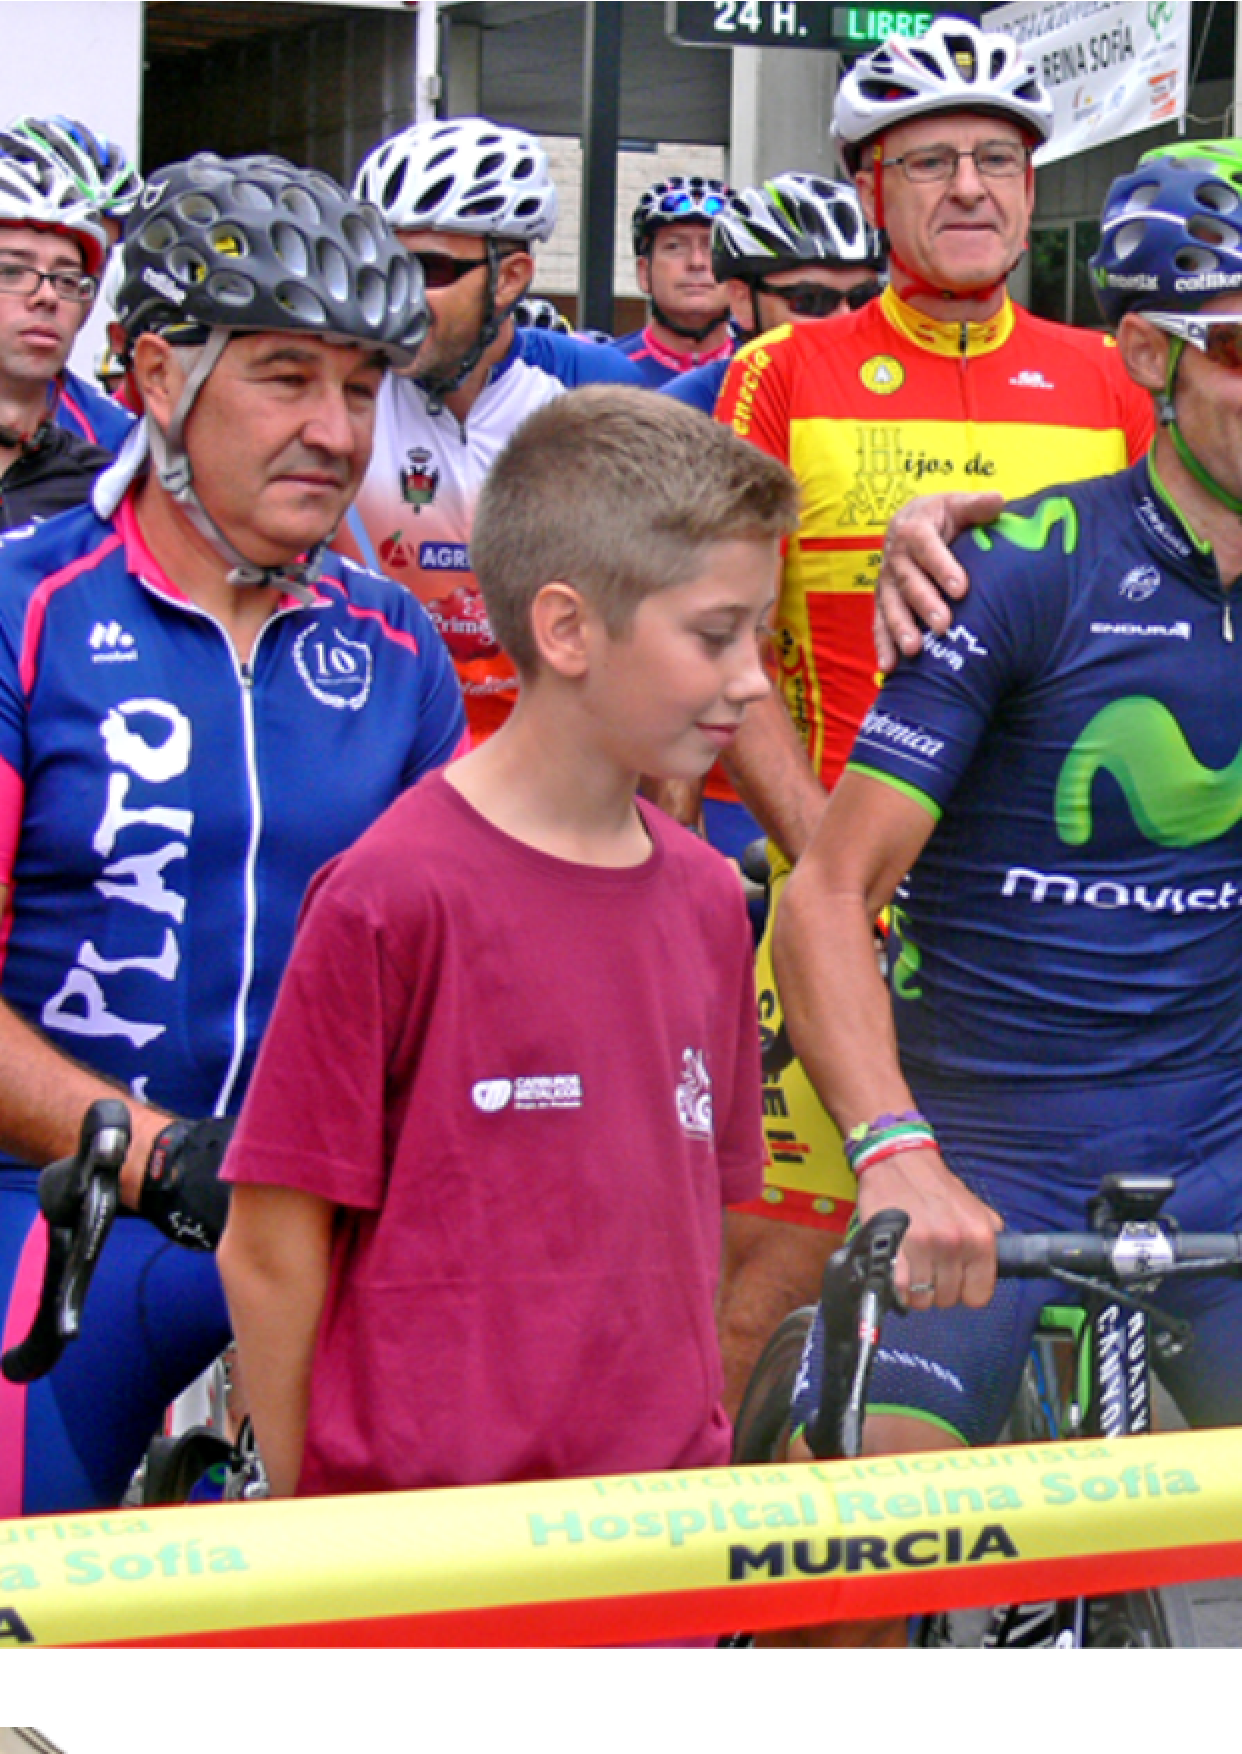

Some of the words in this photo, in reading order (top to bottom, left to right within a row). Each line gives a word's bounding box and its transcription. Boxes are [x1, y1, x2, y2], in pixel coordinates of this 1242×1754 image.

[713, 1, 762, 33] 24
[848, 8, 932, 40] LIBRE
[964, 452, 997, 477] de
[42, 697, 193, 1049] PLATO
[1127, 1309, 1150, 1433] ANYON
[527, 1492, 819, 1546] Hospital
[835, 1482, 1023, 1524] Reina
[1040, 1461, 1202, 1506] Sofía
[64, 1537, 250, 1586] Sofía
[728, 1523, 1019, 1581] MURCIA
